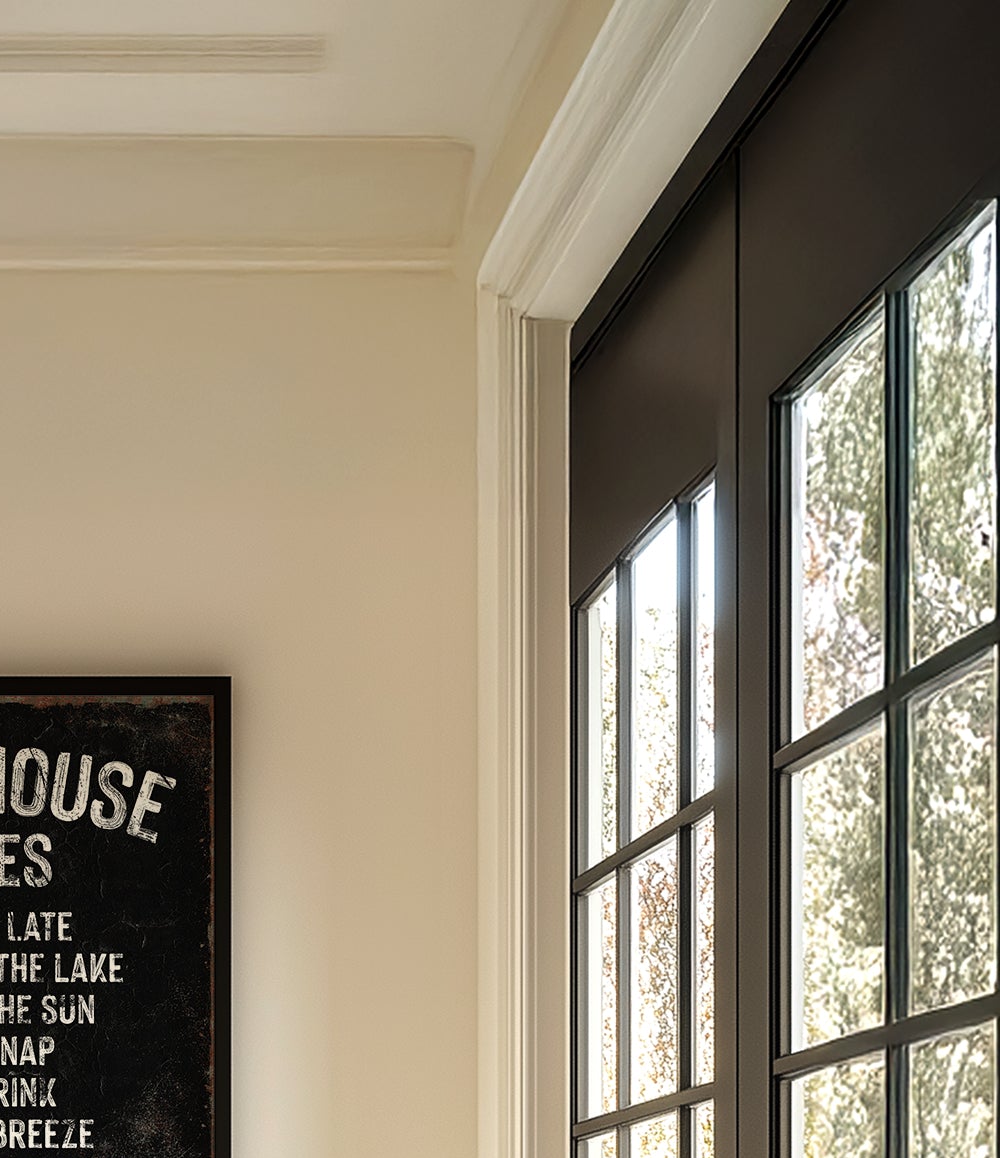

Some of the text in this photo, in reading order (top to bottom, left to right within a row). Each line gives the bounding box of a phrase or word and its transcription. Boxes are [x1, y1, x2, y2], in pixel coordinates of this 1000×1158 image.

[7, 911, 73, 942] LATE
[54, 952, 124, 983] LAKE
[41, 994, 95, 1025] SUN
[0, 1035, 55, 1066] NAP
